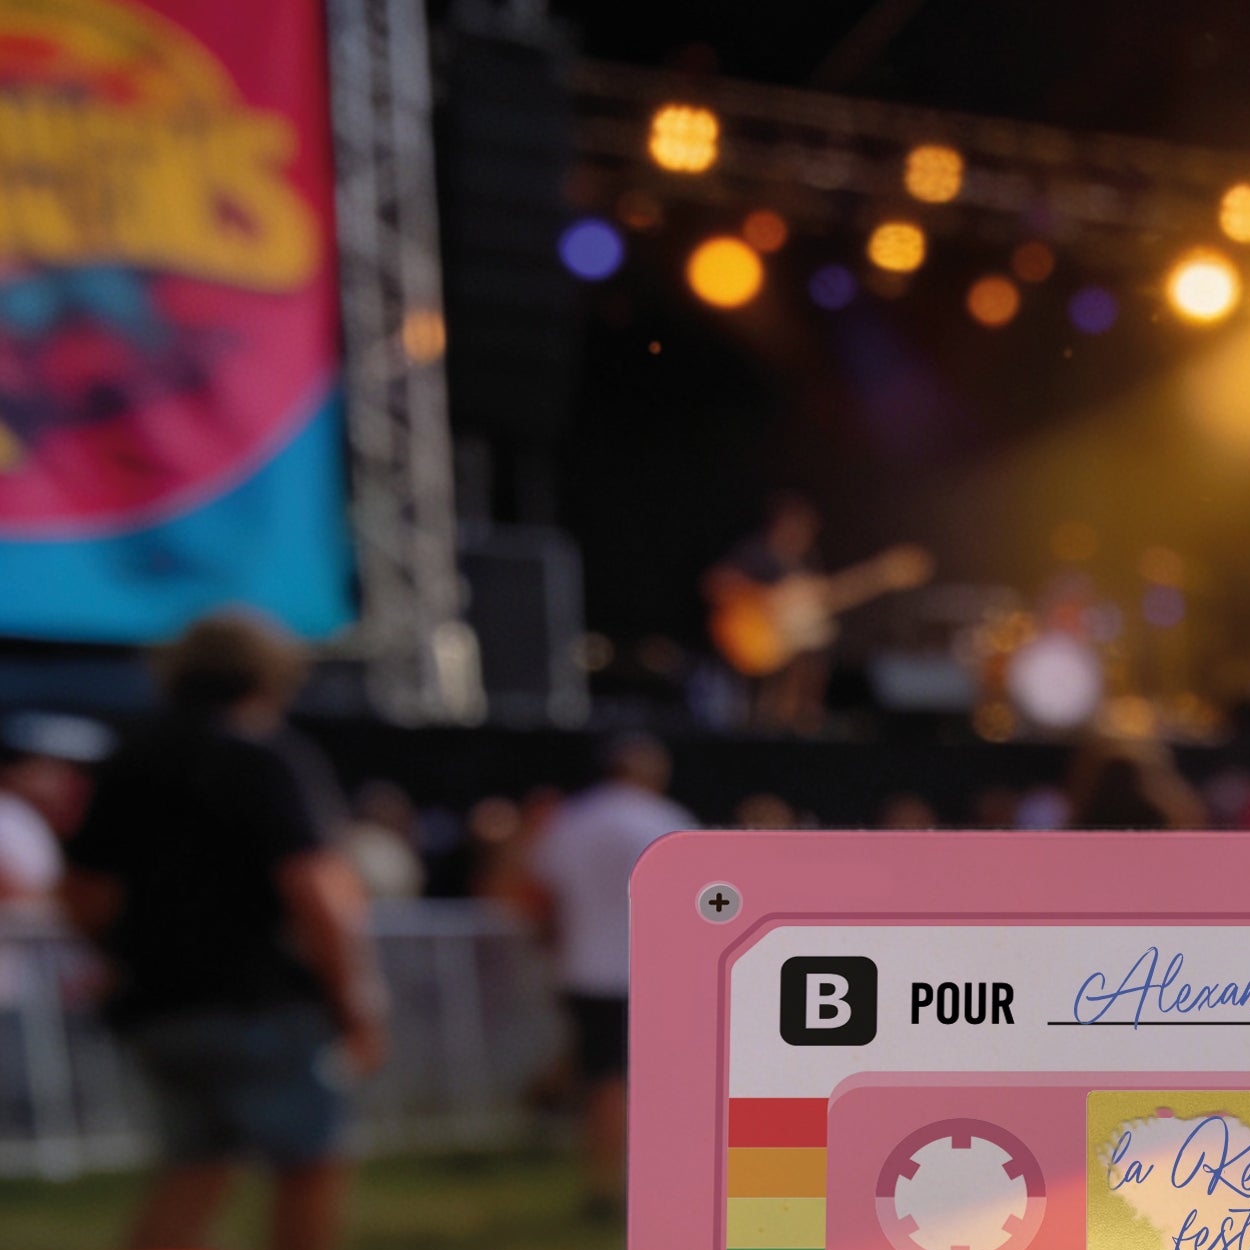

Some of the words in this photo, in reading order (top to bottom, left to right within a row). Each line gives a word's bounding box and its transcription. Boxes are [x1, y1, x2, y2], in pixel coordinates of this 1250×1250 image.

[805, 973, 852, 1029] B
[911, 981, 1015, 1025] POUR
[1107, 1130, 1154, 1191] la
